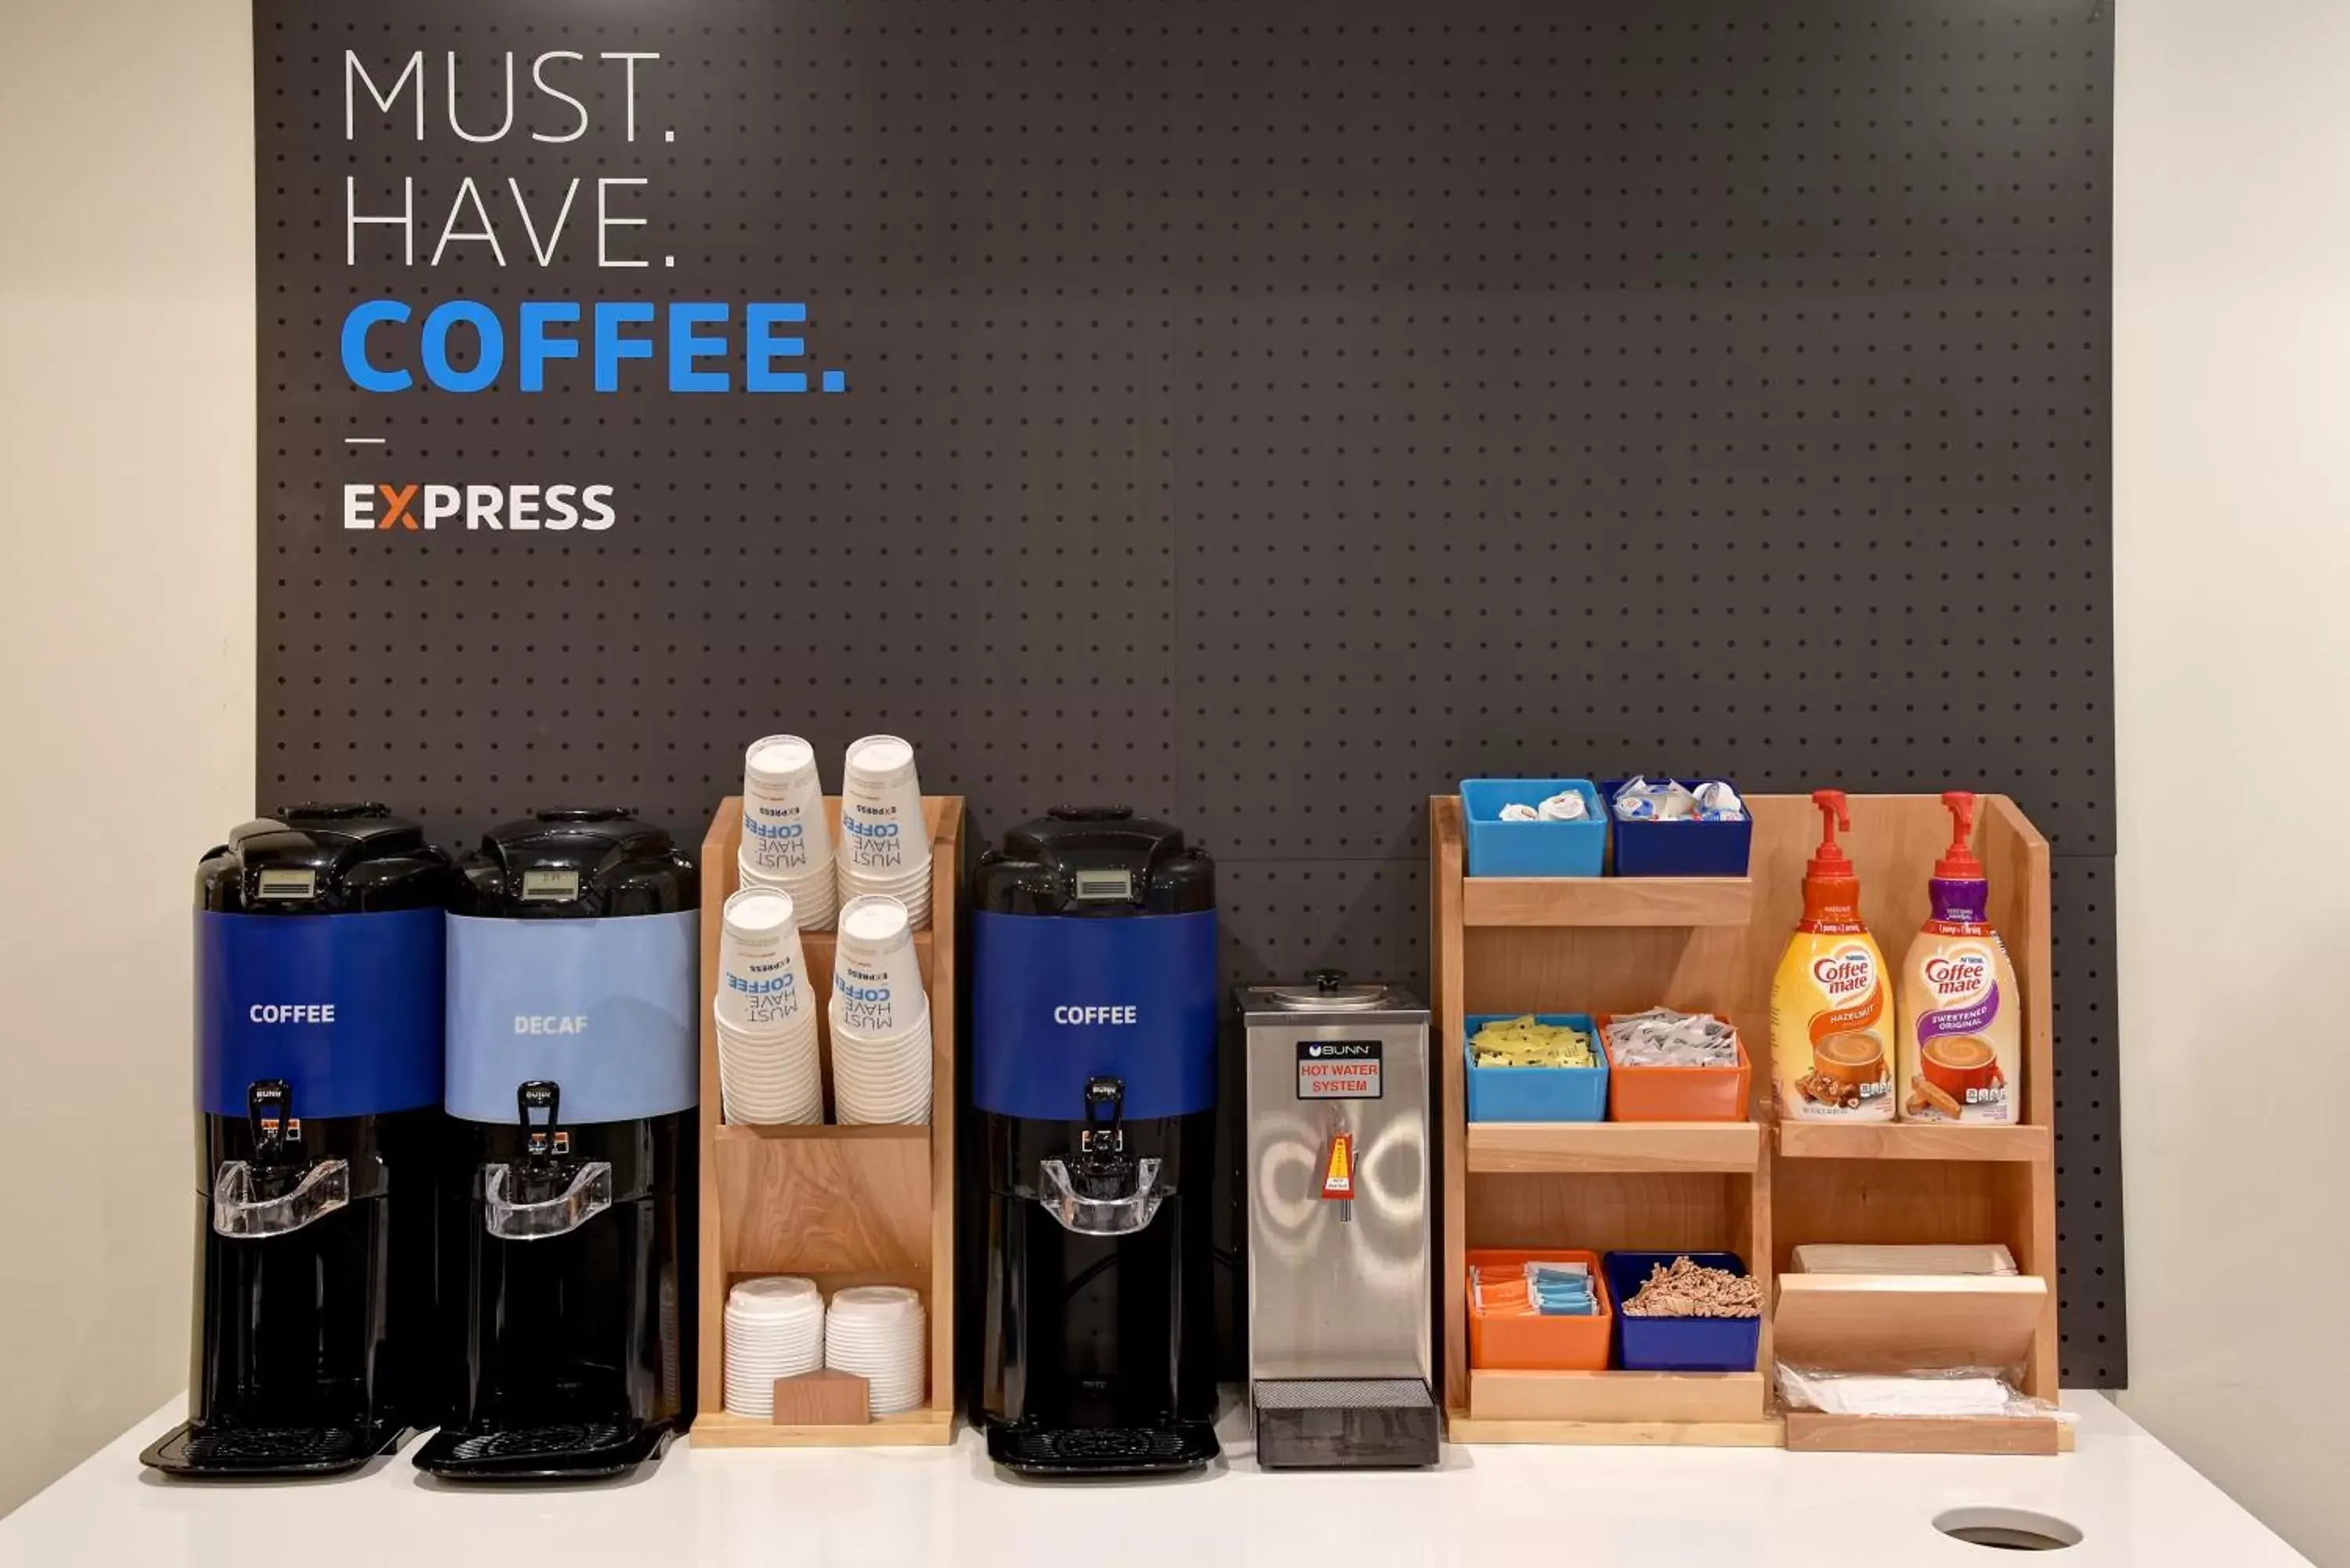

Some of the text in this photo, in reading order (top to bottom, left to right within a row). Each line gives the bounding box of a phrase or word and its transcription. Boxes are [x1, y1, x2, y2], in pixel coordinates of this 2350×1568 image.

[345, 49, 675, 143] MUST.
[347, 175, 675, 268] HAVE.
[340, 299, 846, 393] COFFEE.
[344, 484, 616, 531] EXPRESS
[1813, 958, 1868, 983] Coffee
[1925, 958, 1983, 983] Coffee
[1829, 975, 1868, 995] mate
[1938, 978, 1981, 995] mate
[249, 1003, 335, 1023] COFFEE
[1054, 1005, 1137, 1024] COFFEE
[1829, 1003, 1875, 1024] HAZELNUT
[1931, 1006, 1987, 1024] SWEETENED
[514, 1015, 588, 1035] DECAF
[1939, 1018, 1983, 1031] ORIGINAL
[1321, 1046, 1369, 1056] BUNN
[1301, 1064, 1379, 1076] HOT WATER
[1312, 1080, 1368, 1093] SYSTEM
